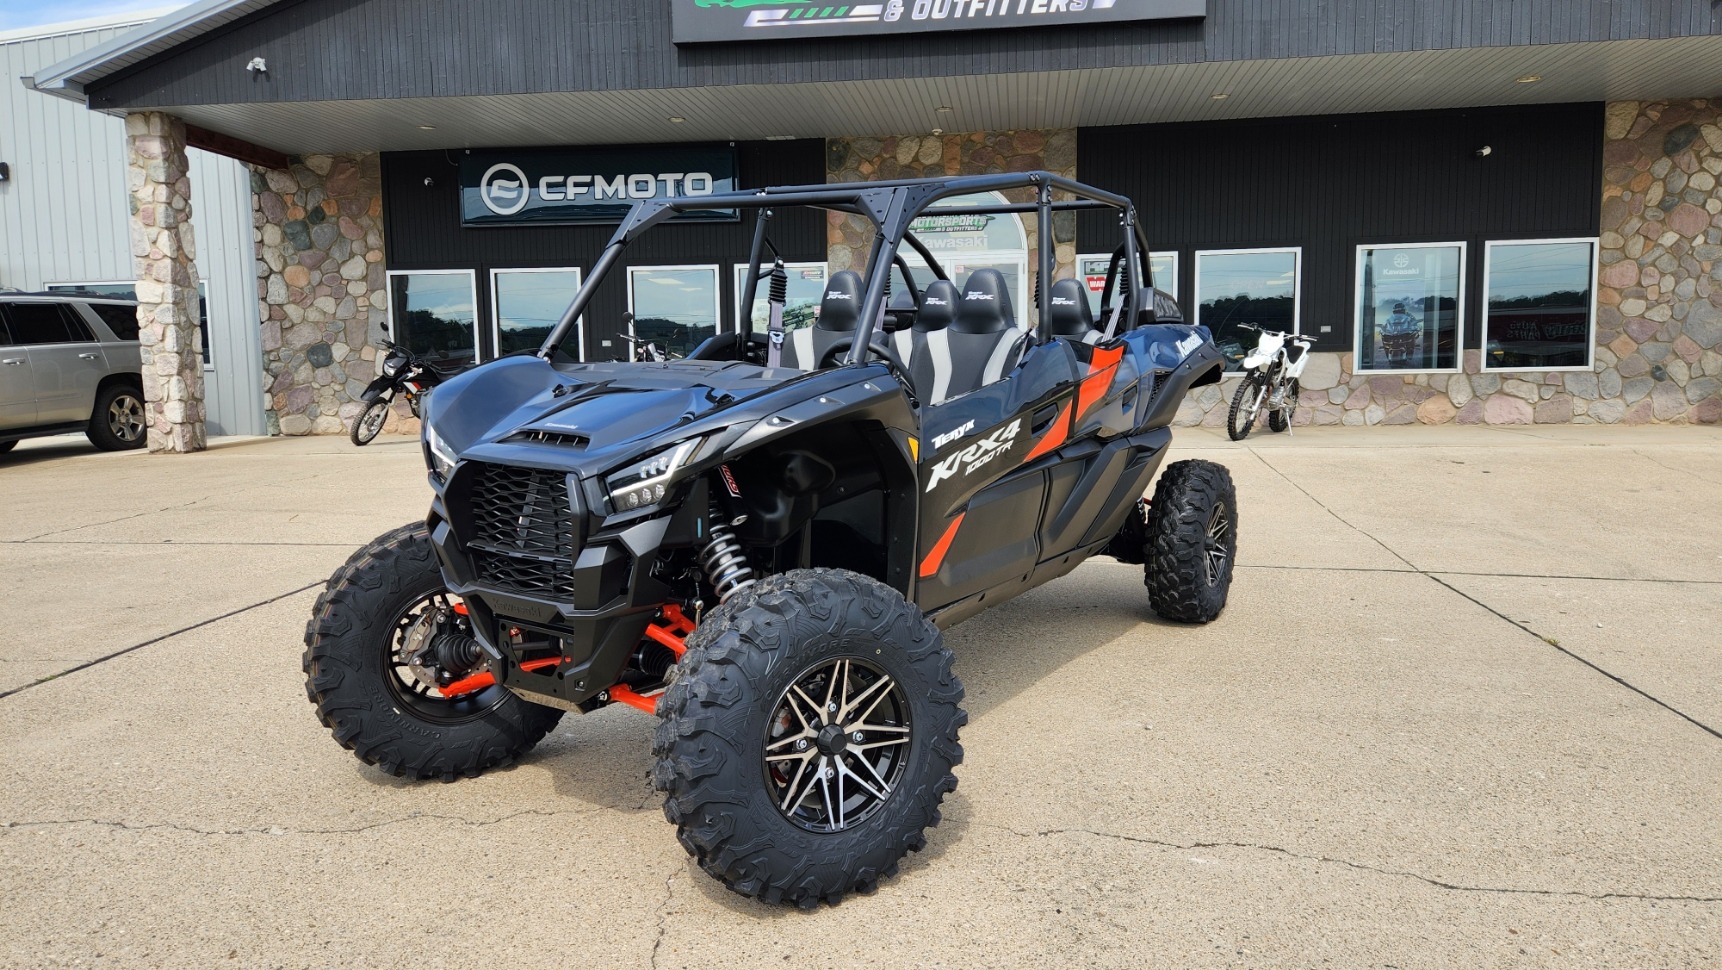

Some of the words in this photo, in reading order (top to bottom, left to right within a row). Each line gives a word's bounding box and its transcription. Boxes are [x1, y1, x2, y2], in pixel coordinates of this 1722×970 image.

[884, 0, 904, 21] &
[911, 0, 1089, 20] OUTFITTERS
[538, 172, 713, 200] CFMOTO
[919, 234, 988, 249] awasaki
[1383, 267, 1419, 275] Kawasaki
[1089, 280, 1106, 288] WAR
